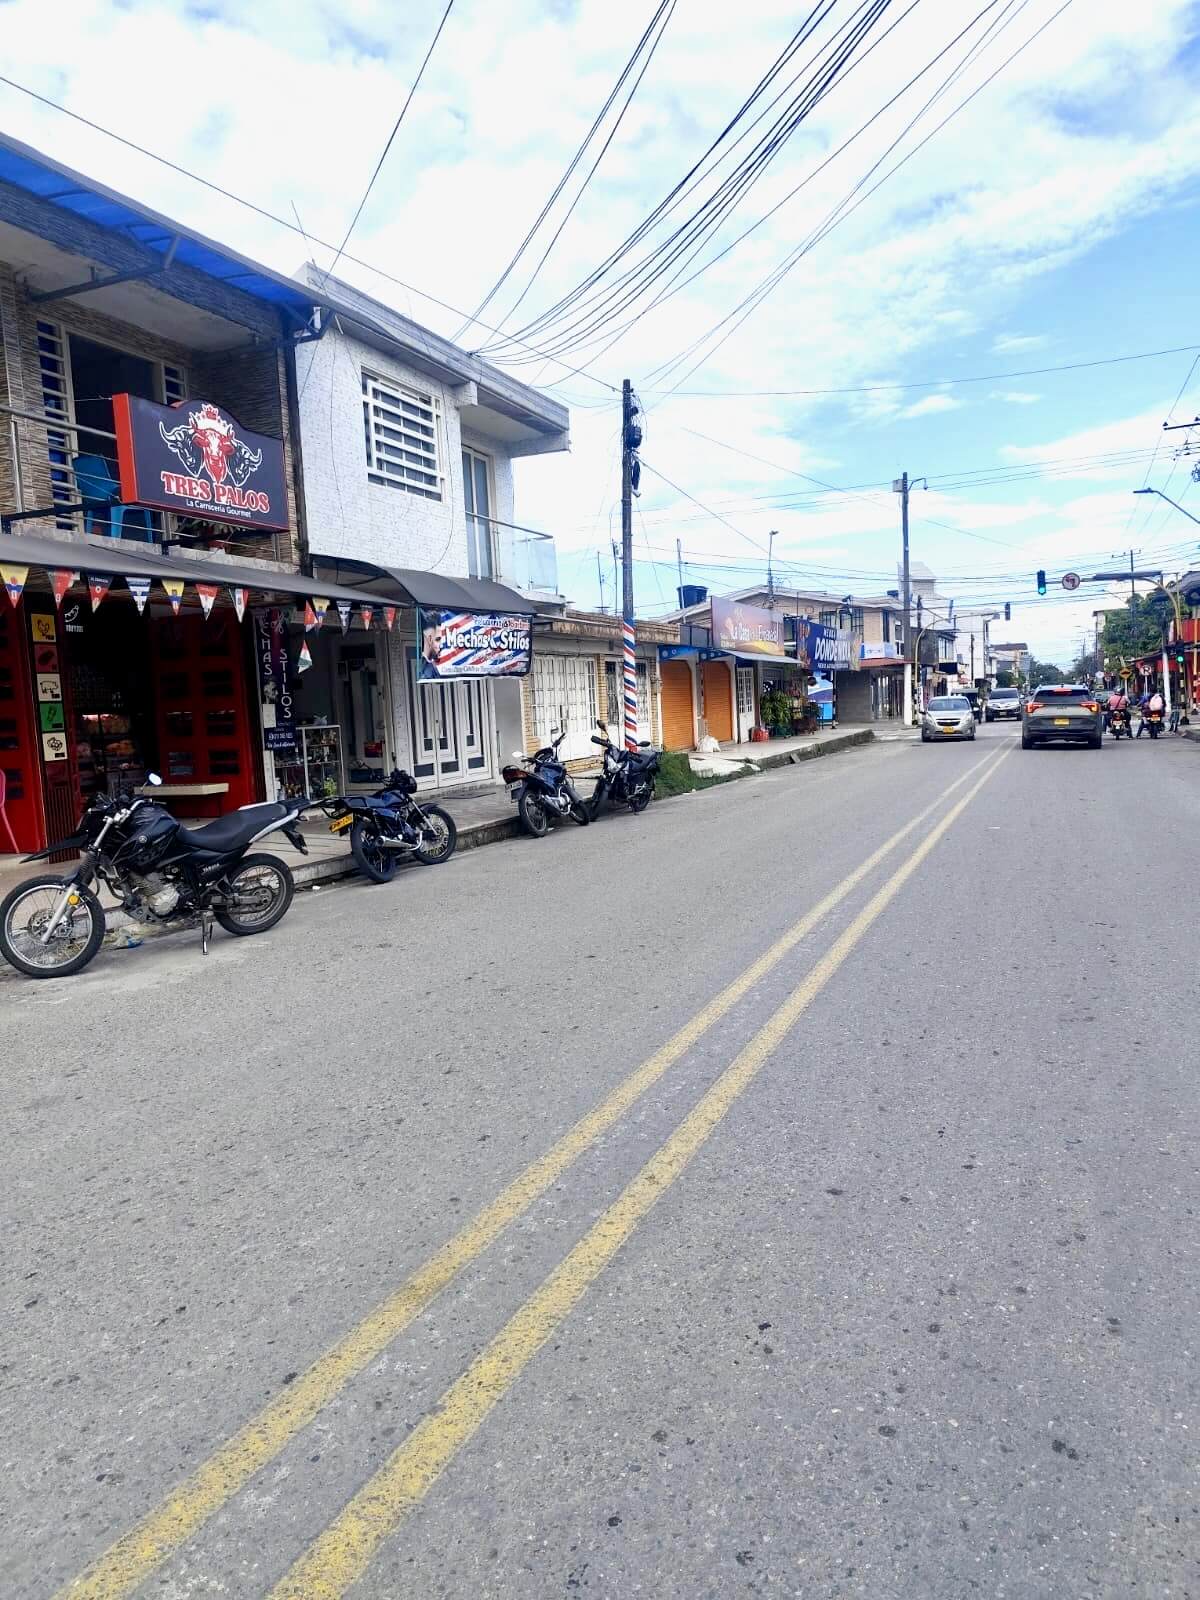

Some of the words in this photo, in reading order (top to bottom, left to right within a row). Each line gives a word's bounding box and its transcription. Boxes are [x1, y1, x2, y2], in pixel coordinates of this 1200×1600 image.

[161, 471, 212, 501] TRES
[214, 482, 270, 513] PALOS
[186, 499, 194, 507] La
[446, 628, 488, 649] Mechas
[500, 630, 530, 650] Stilos
[280, 648, 292, 719] STILOS
